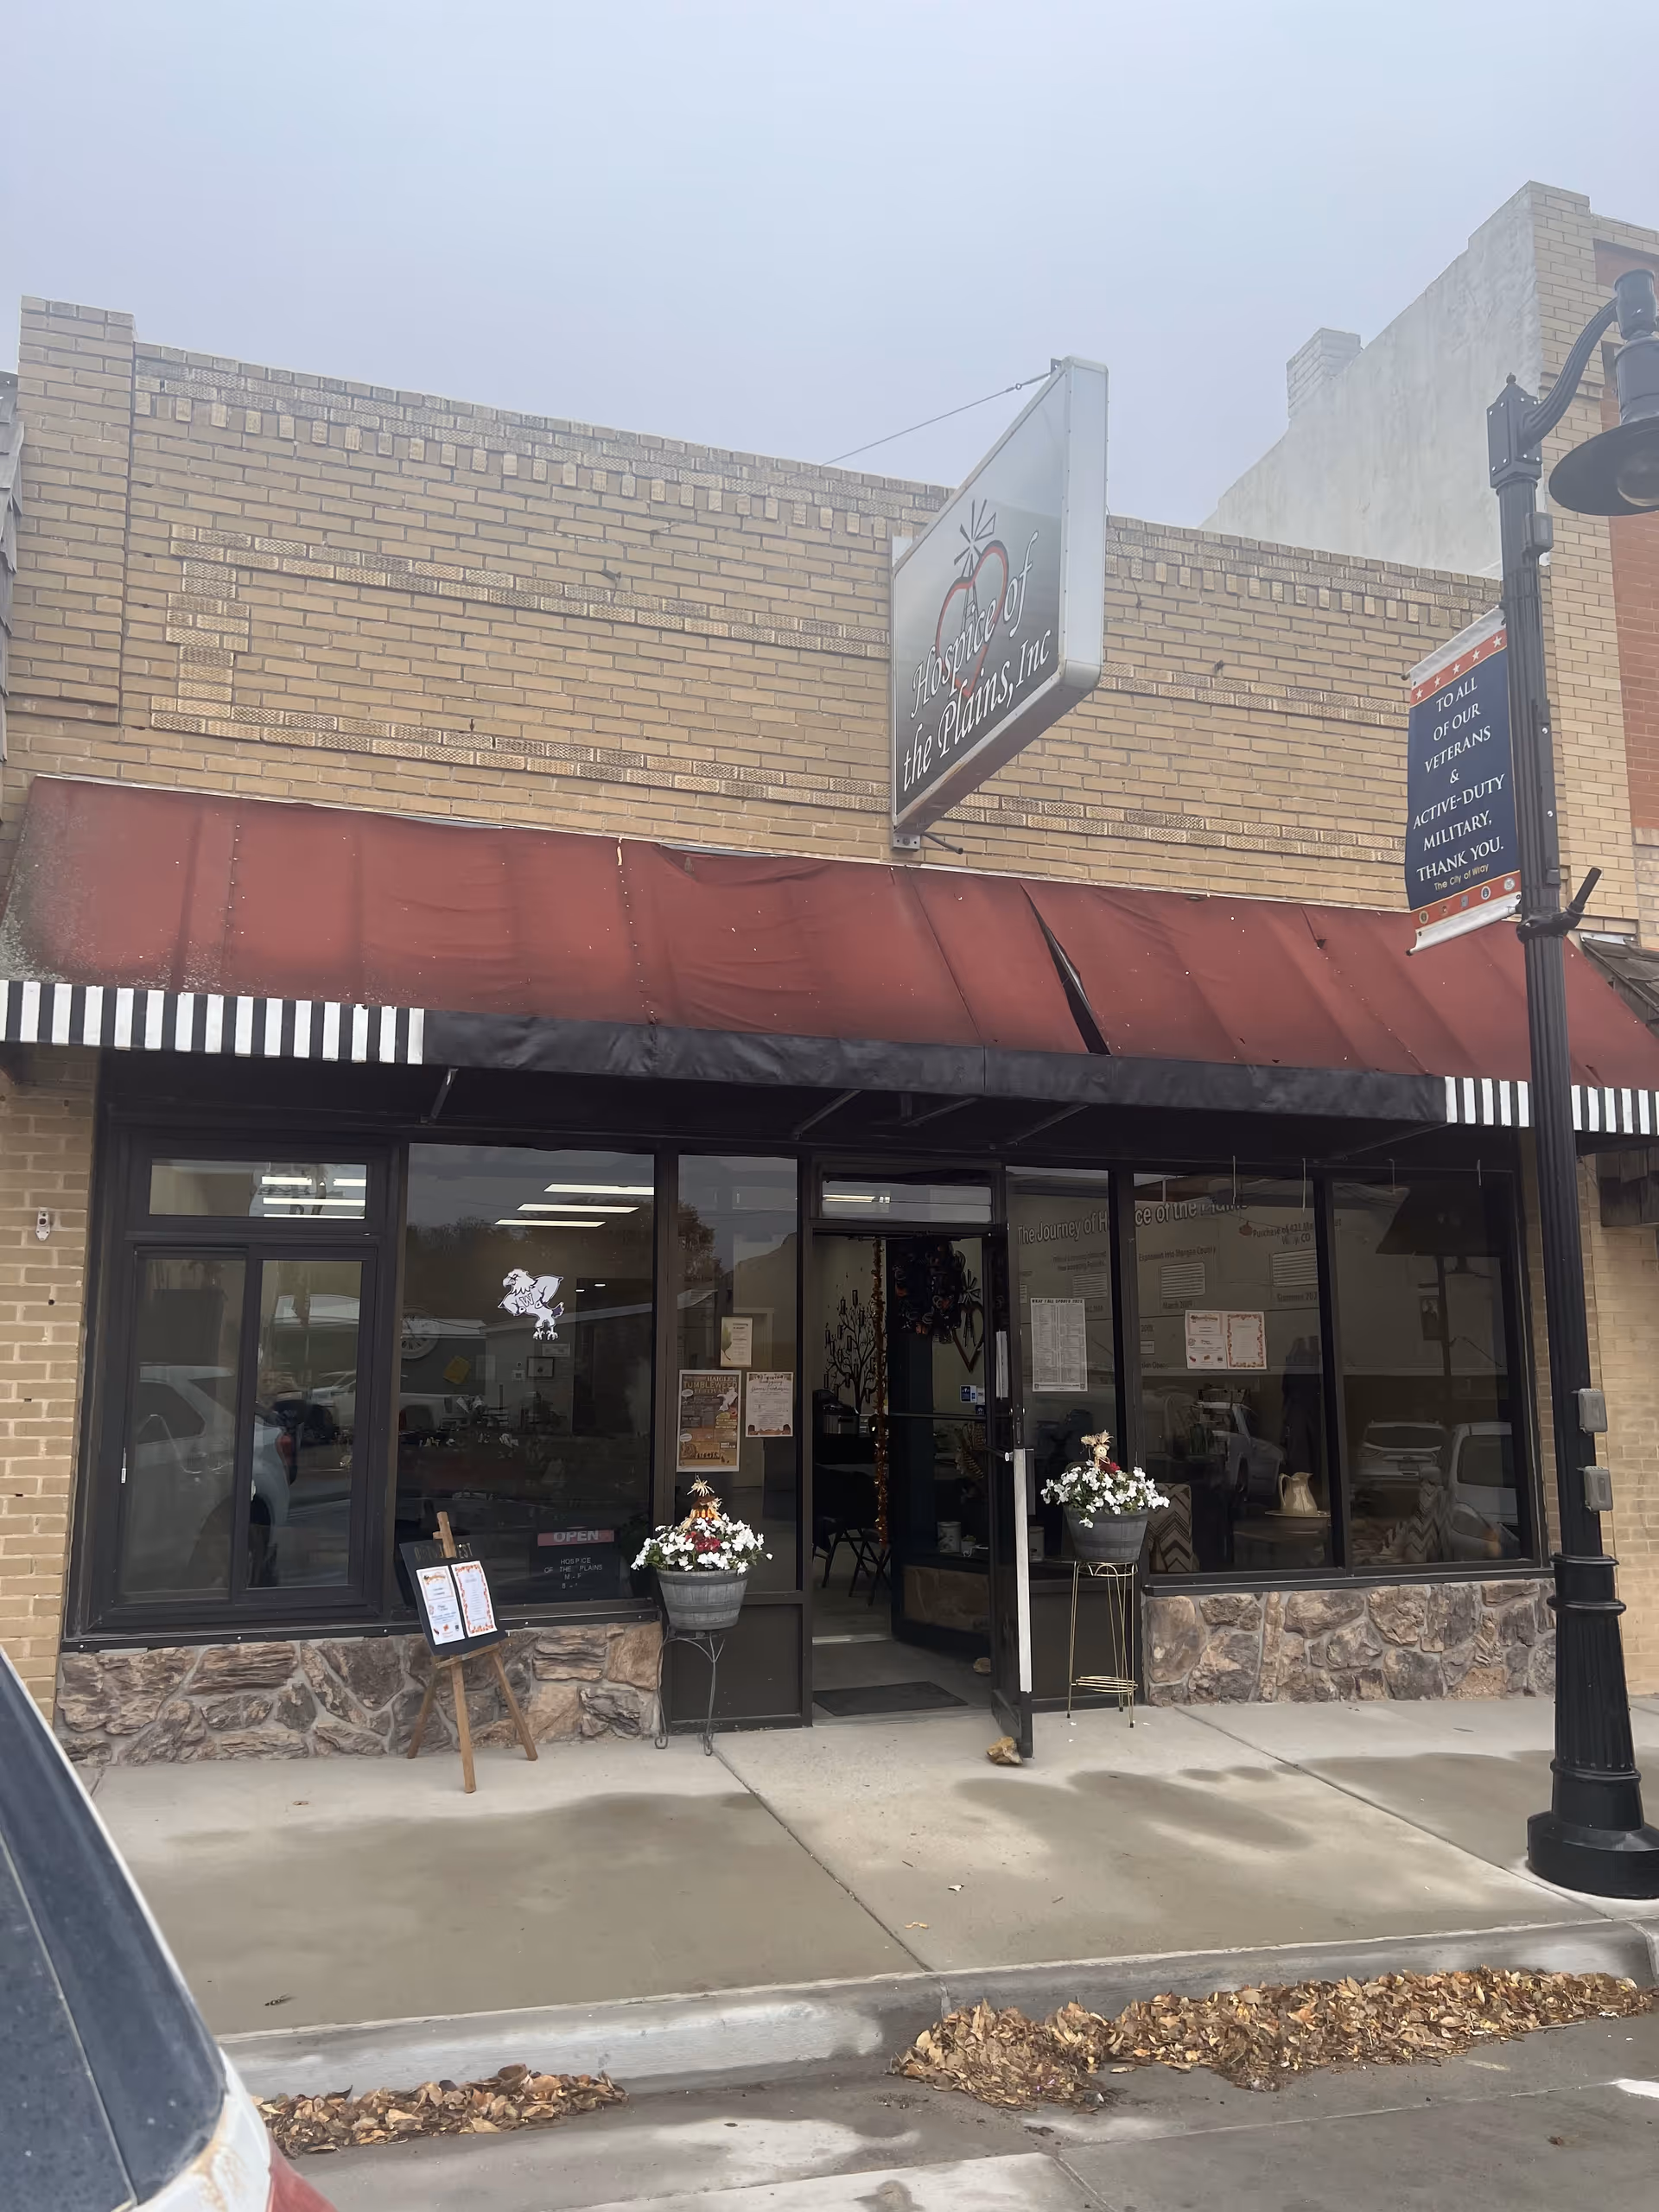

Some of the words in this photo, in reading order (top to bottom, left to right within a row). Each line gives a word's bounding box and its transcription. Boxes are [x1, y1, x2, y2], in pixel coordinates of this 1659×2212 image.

[910, 597, 997, 719] Hospice
[1003, 530, 1040, 639] of
[903, 723, 932, 792] the
[938, 659, 1014, 760] Plains,
[1014, 629, 1052, 689] Inc
[1436, 692, 1454, 713] TO
[1455, 677, 1478, 702] ALL
[1433, 717, 1451, 742] OF
[1451, 703, 1482, 732] OUR
[1424, 724, 1492, 774] VETERANS
[1449, 768, 1459, 784] &
[1413, 773, 1506, 830] ACTIVE-DUTY
[1422, 809, 1492, 852] MILITARY,
[1416, 849, 1467, 883] THANK
[1469, 836, 1505, 865] YOU.
[1433, 876, 1448, 892] The
[1449, 873, 1463, 889] City
[1464, 869, 1471, 883] of
[1472, 863, 1490, 882] Wray
[1017, 1224, 1036, 1244] The
[1037, 1221, 1081, 1242] Journey
[1084, 1212, 1096, 1234] of
[1156, 1203, 1173, 1224] of
[1173, 1201, 1198, 1220] the
[1300, 1232, 1311, 1243] CO
[519, 1293, 534, 1307] W
[683, 1381, 737, 1389] TUMBLEWEED
[553, 1529, 599, 1542] OPEN
